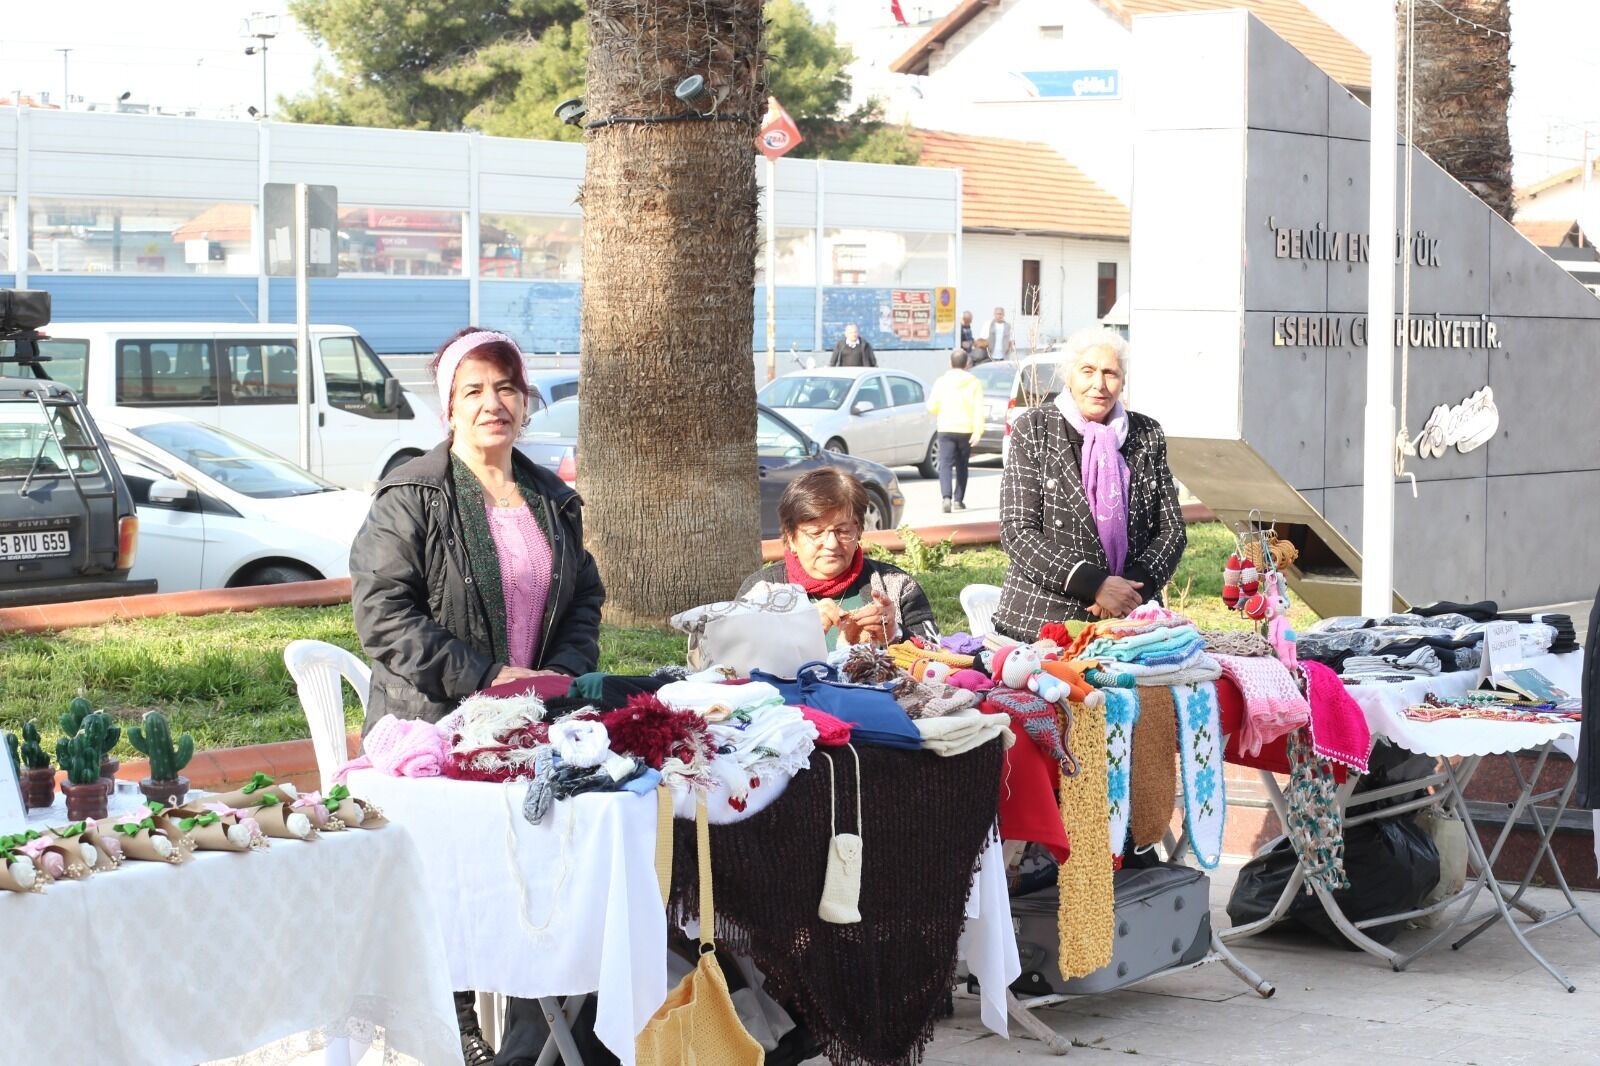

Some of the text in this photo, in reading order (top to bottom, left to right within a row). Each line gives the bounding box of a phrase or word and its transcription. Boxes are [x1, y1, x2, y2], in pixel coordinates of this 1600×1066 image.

[1346, 232, 1369, 262] EN
[1393, 229, 1442, 267] ÜYÜK
[1351, 312, 1502, 349] CHURİYETTİR.
[13, 534, 37, 553] BYU
[42, 533, 66, 551] 659
